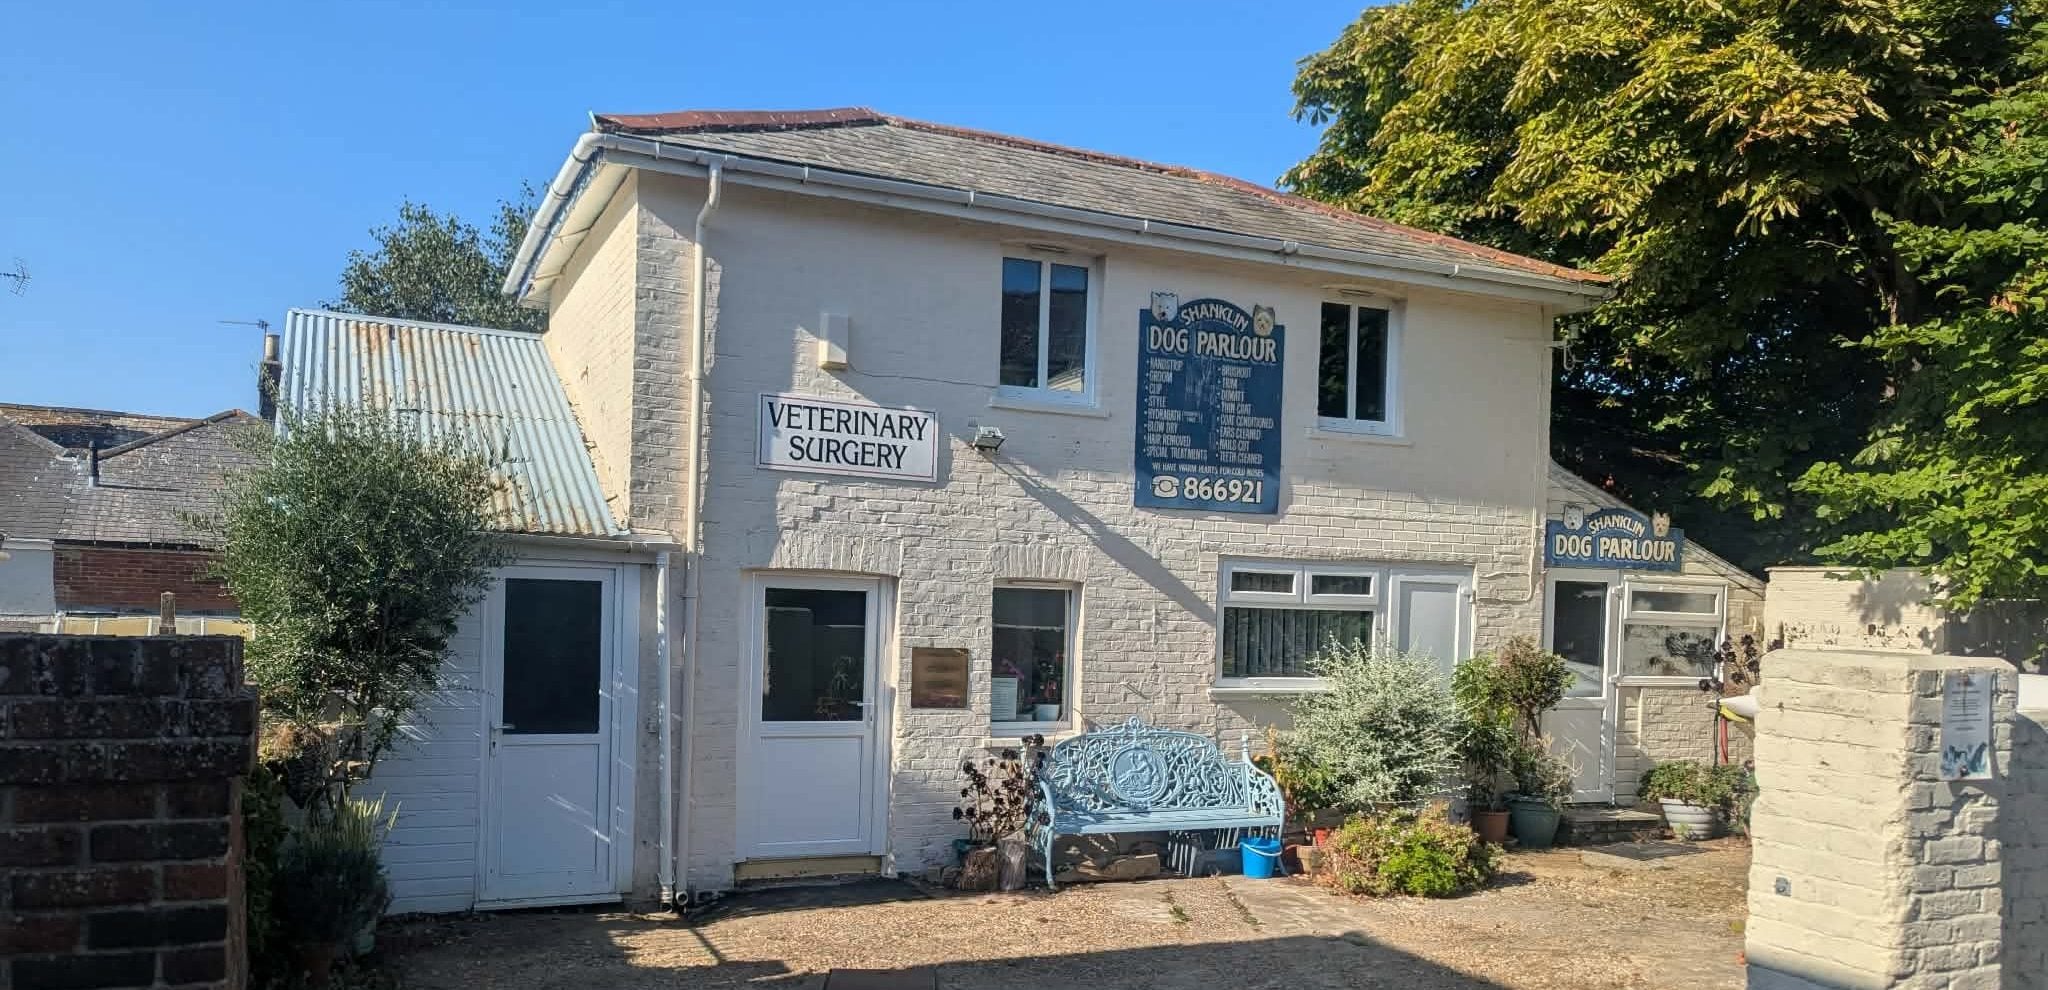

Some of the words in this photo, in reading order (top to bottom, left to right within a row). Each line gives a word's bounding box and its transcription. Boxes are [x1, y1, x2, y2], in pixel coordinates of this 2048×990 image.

[1181, 303, 1249, 332] SHANKLIN
[1149, 325, 1189, 353] DOG
[1196, 330, 1277, 362] PARLOUR
[1149, 370, 1173, 384] GROOM
[1222, 377, 1238, 389] TRIM
[1149, 383, 1163, 394] CLIP
[1148, 395, 1168, 408] STYLE
[1236, 403, 1252, 416] COAT
[768, 401, 929, 441] VETERINARY
[1147, 420, 1165, 433] BLOW
[1165, 422, 1178, 434] DRY
[1220, 413, 1235, 426] COAT
[1235, 415, 1274, 429] CONDITIONED
[1220, 426, 1235, 438] EARS
[1235, 427, 1261, 440] CLEANED
[1162, 434, 1191, 447] REMOVED
[1219, 438, 1237, 451] NAILS
[1237, 440, 1250, 452] CUT
[788, 435, 908, 470] SURGERY
[1146, 445, 1168, 458] SPECIAL
[1170, 447, 1208, 460] TREATMENTS
[1220, 450, 1236, 462] TEETH
[1237, 452, 1263, 465] CLEANED
[1162, 463, 1177, 472] HAVE
[1178, 464, 1197, 473] WARM
[1183, 476, 1262, 504] 866921
[1588, 515, 1645, 538] SHANKLIN
[1555, 534, 1593, 557] DOG
[1599, 537, 1675, 562] PARLOUR
